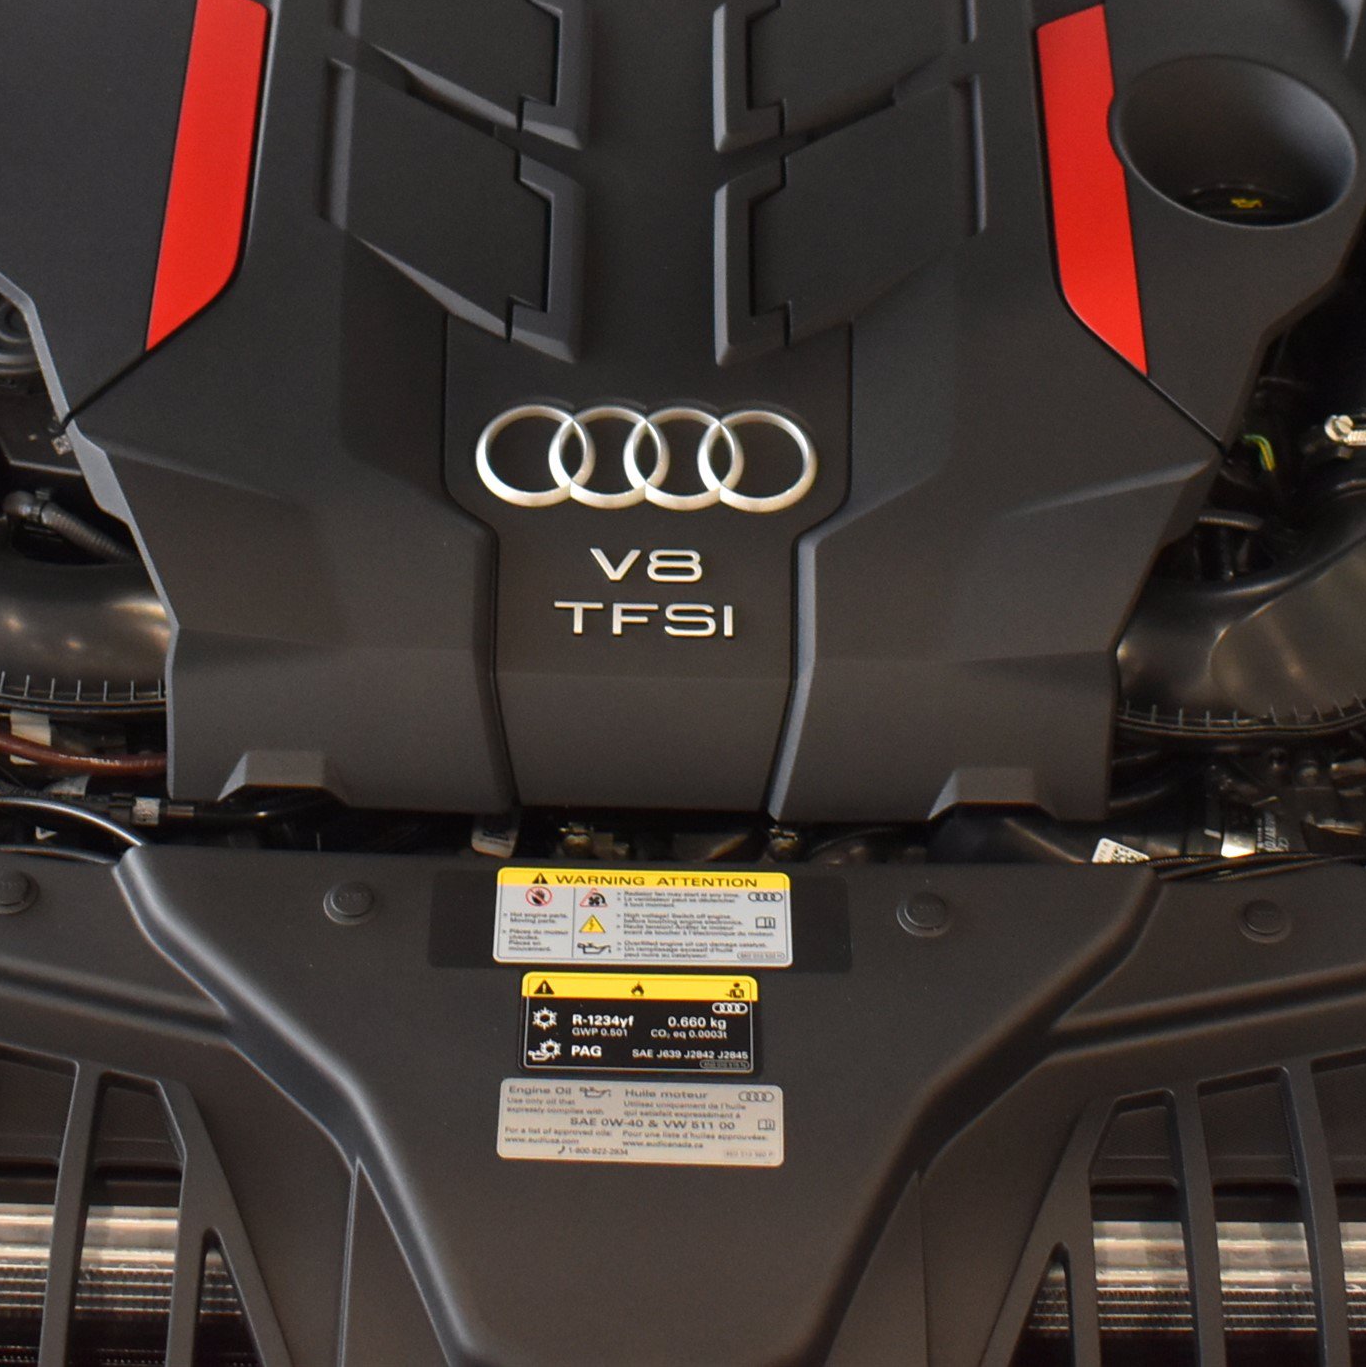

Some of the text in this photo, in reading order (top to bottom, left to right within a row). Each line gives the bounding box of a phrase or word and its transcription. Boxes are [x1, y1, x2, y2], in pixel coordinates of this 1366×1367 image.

[590, 547, 703, 583] V8
[554, 600, 734, 637] TFSI
[555, 874, 757, 887] WARNING ATTENTION
[572, 1014, 727, 1031] R-1234yf 0.660 kg
[572, 1027, 599, 1037] GWP
[571, 1045, 603, 1058] PAG
[632, 1048, 654, 1059] SAE
[656, 1049, 682, 1059] J639
[508, 1085, 572, 1096] Engine Oil
[624, 1088, 708, 1099] Huile moteur
[570, 1117, 735, 1130] SAE 0W-40 & VW 511 00
